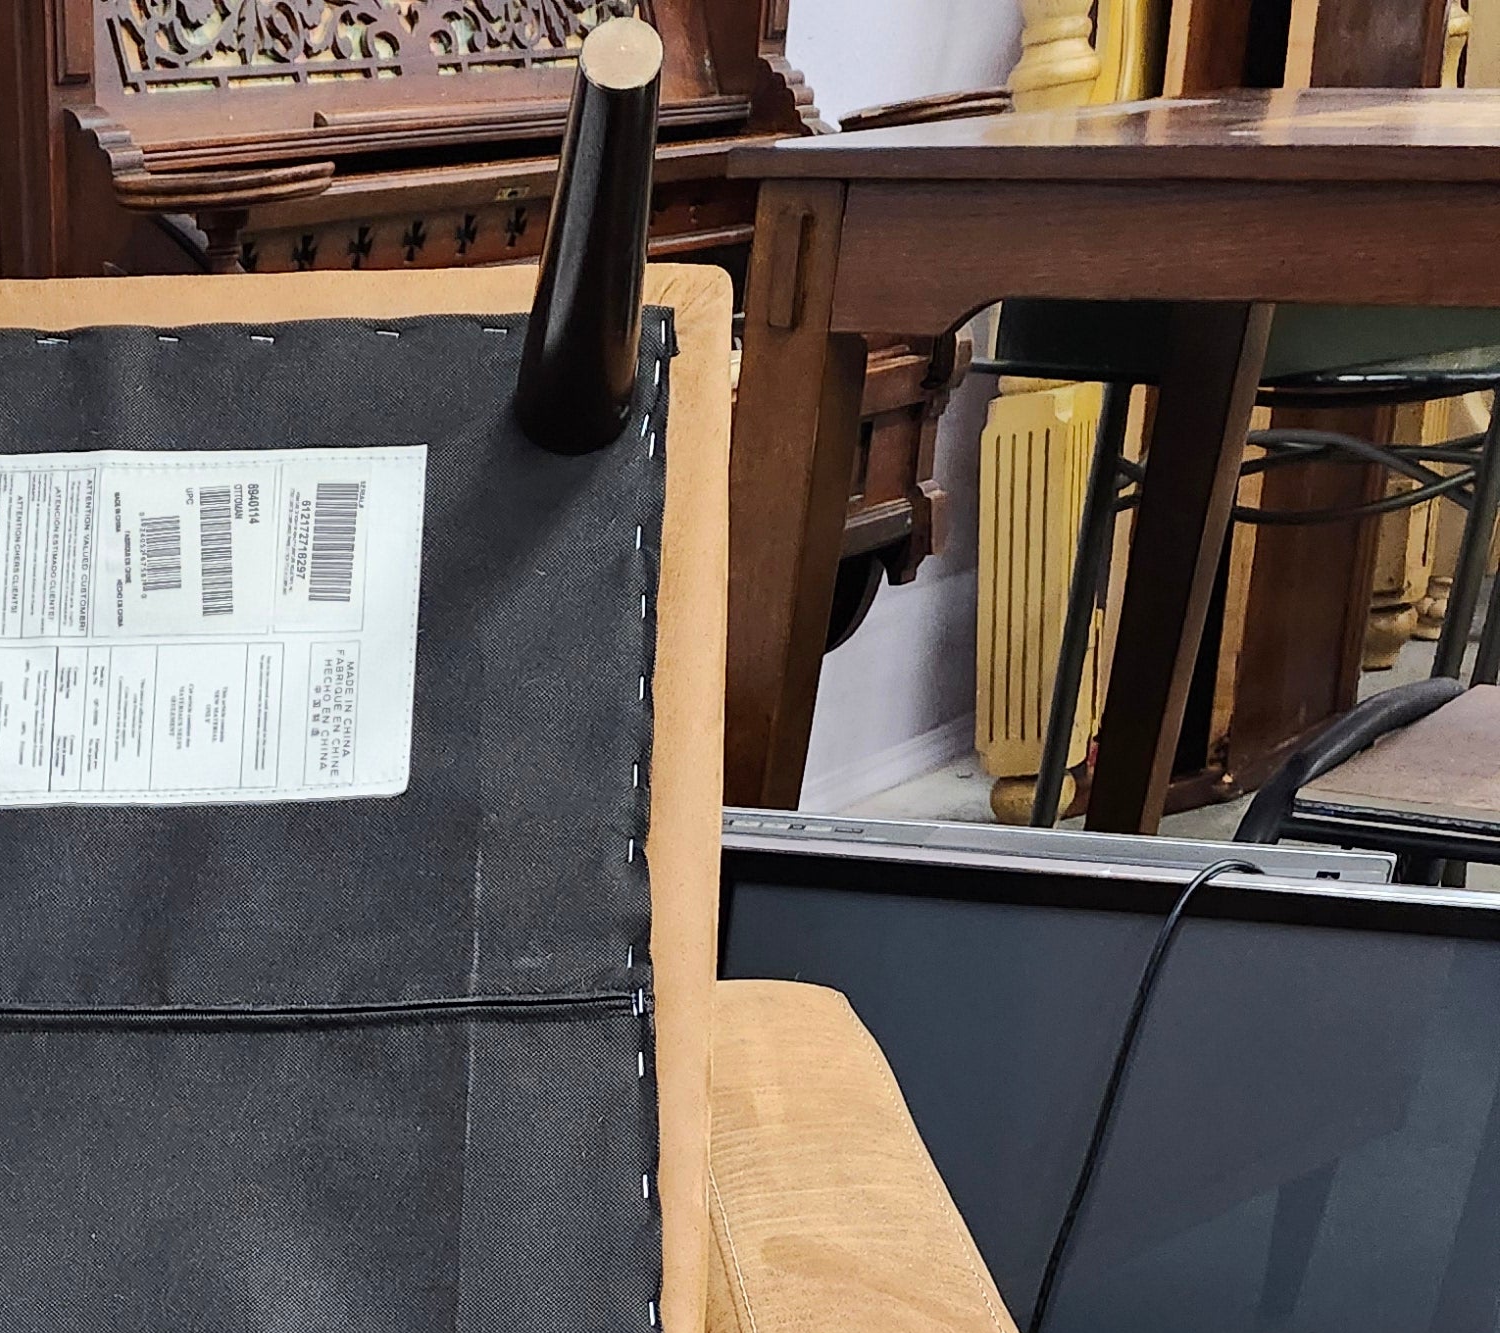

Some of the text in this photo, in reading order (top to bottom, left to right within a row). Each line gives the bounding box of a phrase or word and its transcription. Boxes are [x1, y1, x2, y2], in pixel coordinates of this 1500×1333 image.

[15, 496, 23, 542] ATTENTION
[234, 484, 243, 519] OTTOMAN
[248, 484, 260, 524] 8940114
[296, 500, 311, 579] 612172718297
[51, 534, 59, 578] ESTIMADO
[79, 480, 92, 631] ATTENTION VALUED CUSTOMER!
[320, 660, 332, 770] HECHO EN CHINA
[331, 649, 344, 776] FABRIQUE EN CHINE
[342, 662, 354, 757] MADE IN CHINA
